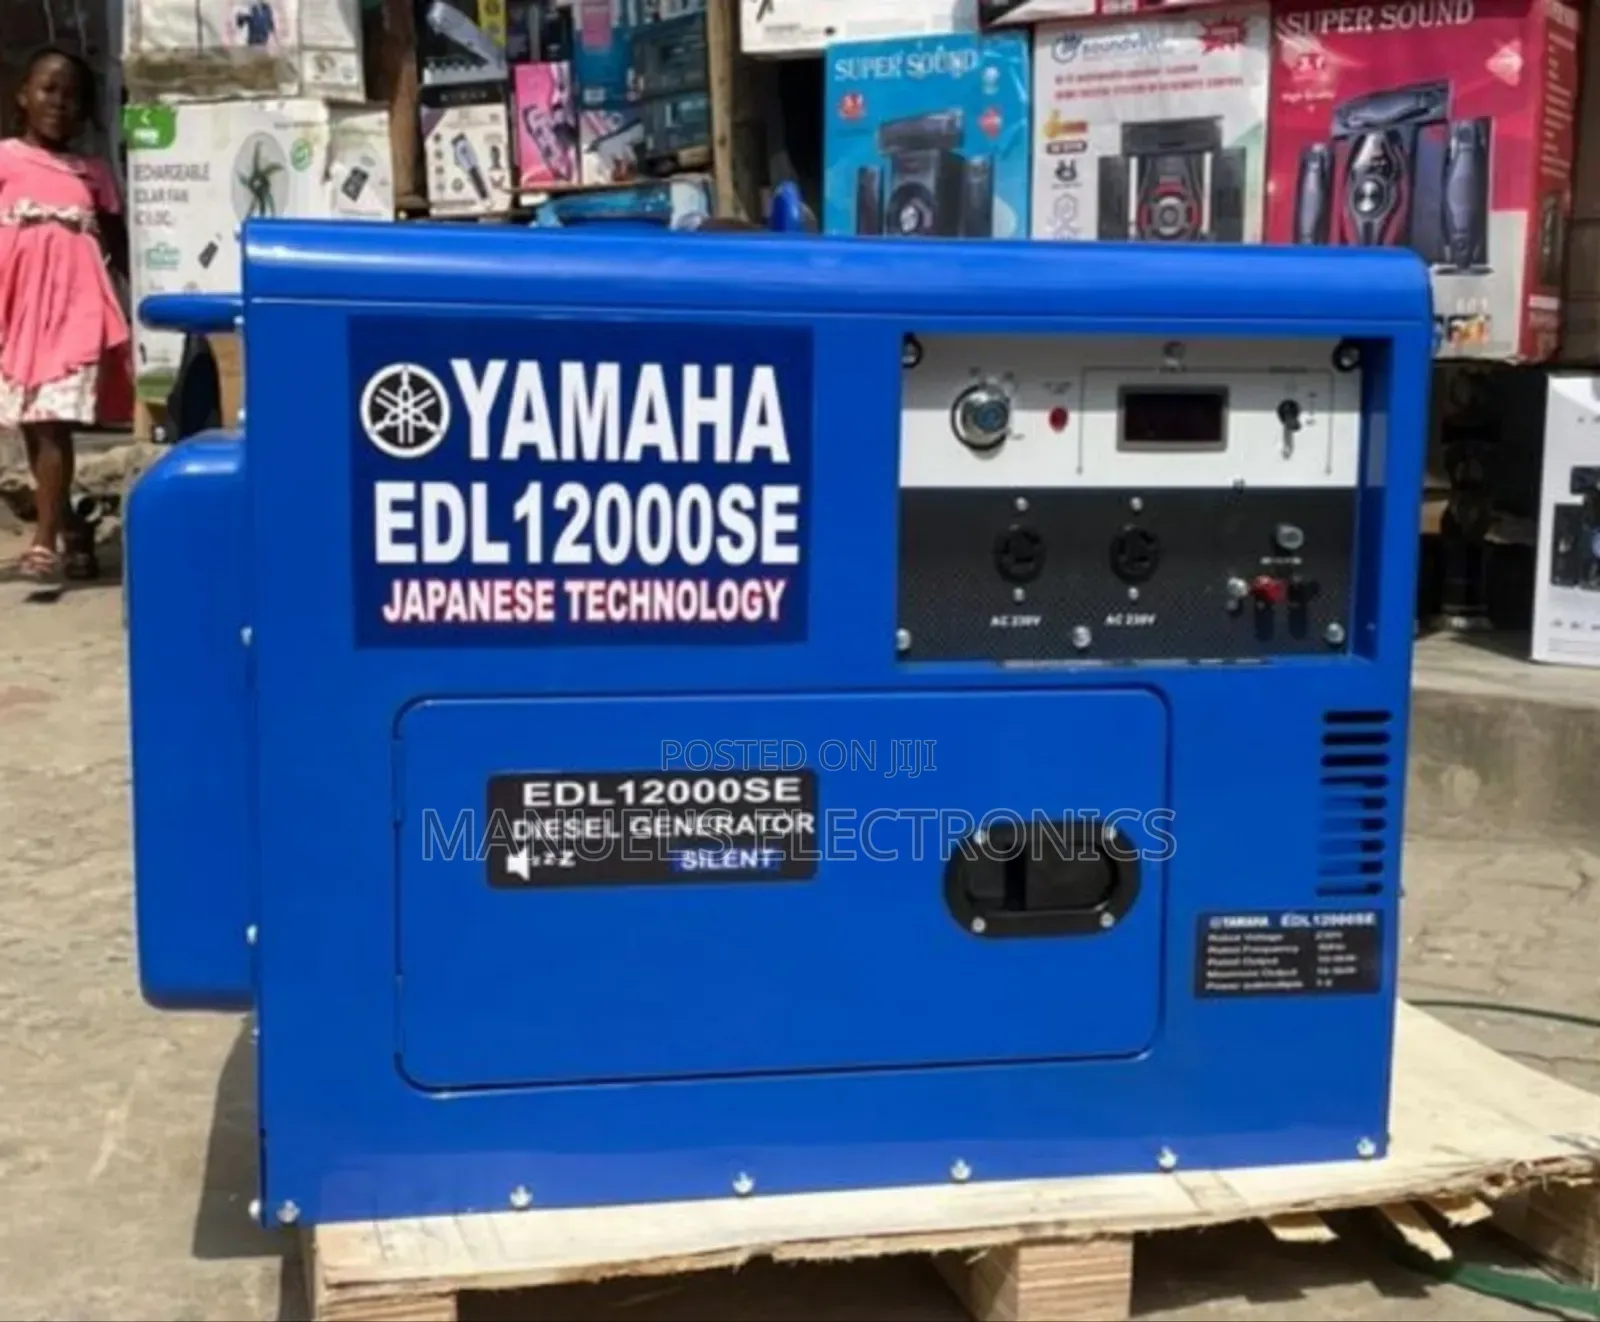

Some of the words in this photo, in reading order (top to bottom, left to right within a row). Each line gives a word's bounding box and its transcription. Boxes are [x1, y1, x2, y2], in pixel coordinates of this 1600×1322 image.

[1287, 6, 1374, 35] SUPER
[1379, 0, 1475, 30] SOUND
[834, 53, 904, 82] SUPER
[450, 357, 791, 464] YAMAHA
[373, 480, 801, 565] EDL12000SE
[382, 578, 556, 623] JAPANESE
[563, 578, 787, 623] TECHNOLOGY
[523, 778, 802, 807] EDL12000SE
[513, 818, 620, 841] DIESEL
[629, 813, 816, 838] GENERATOR
[680, 849, 775, 870] SILENT
